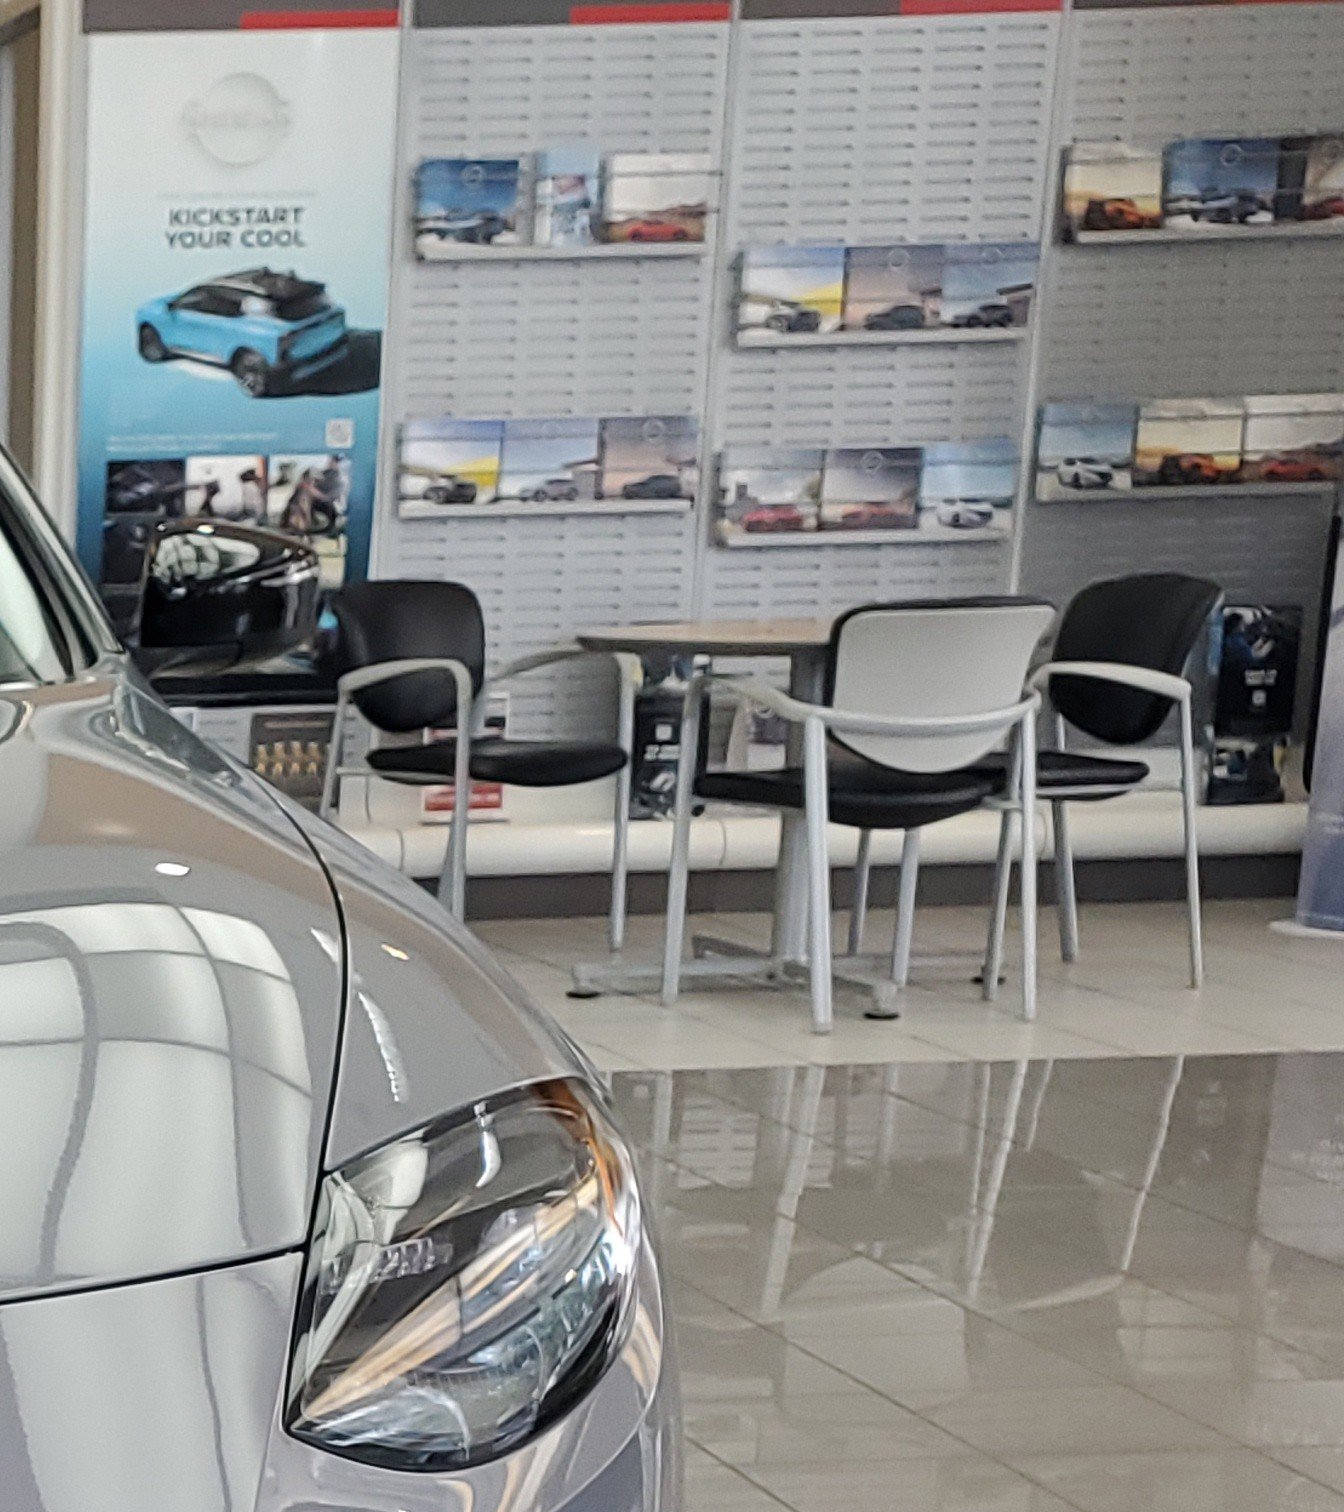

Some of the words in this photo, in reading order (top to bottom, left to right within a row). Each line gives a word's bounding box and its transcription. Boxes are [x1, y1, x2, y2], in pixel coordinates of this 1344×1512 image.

[168, 207, 305, 227] KICKSTART
[164, 230, 232, 249] YOUR
[240, 229, 306, 248] COOL
